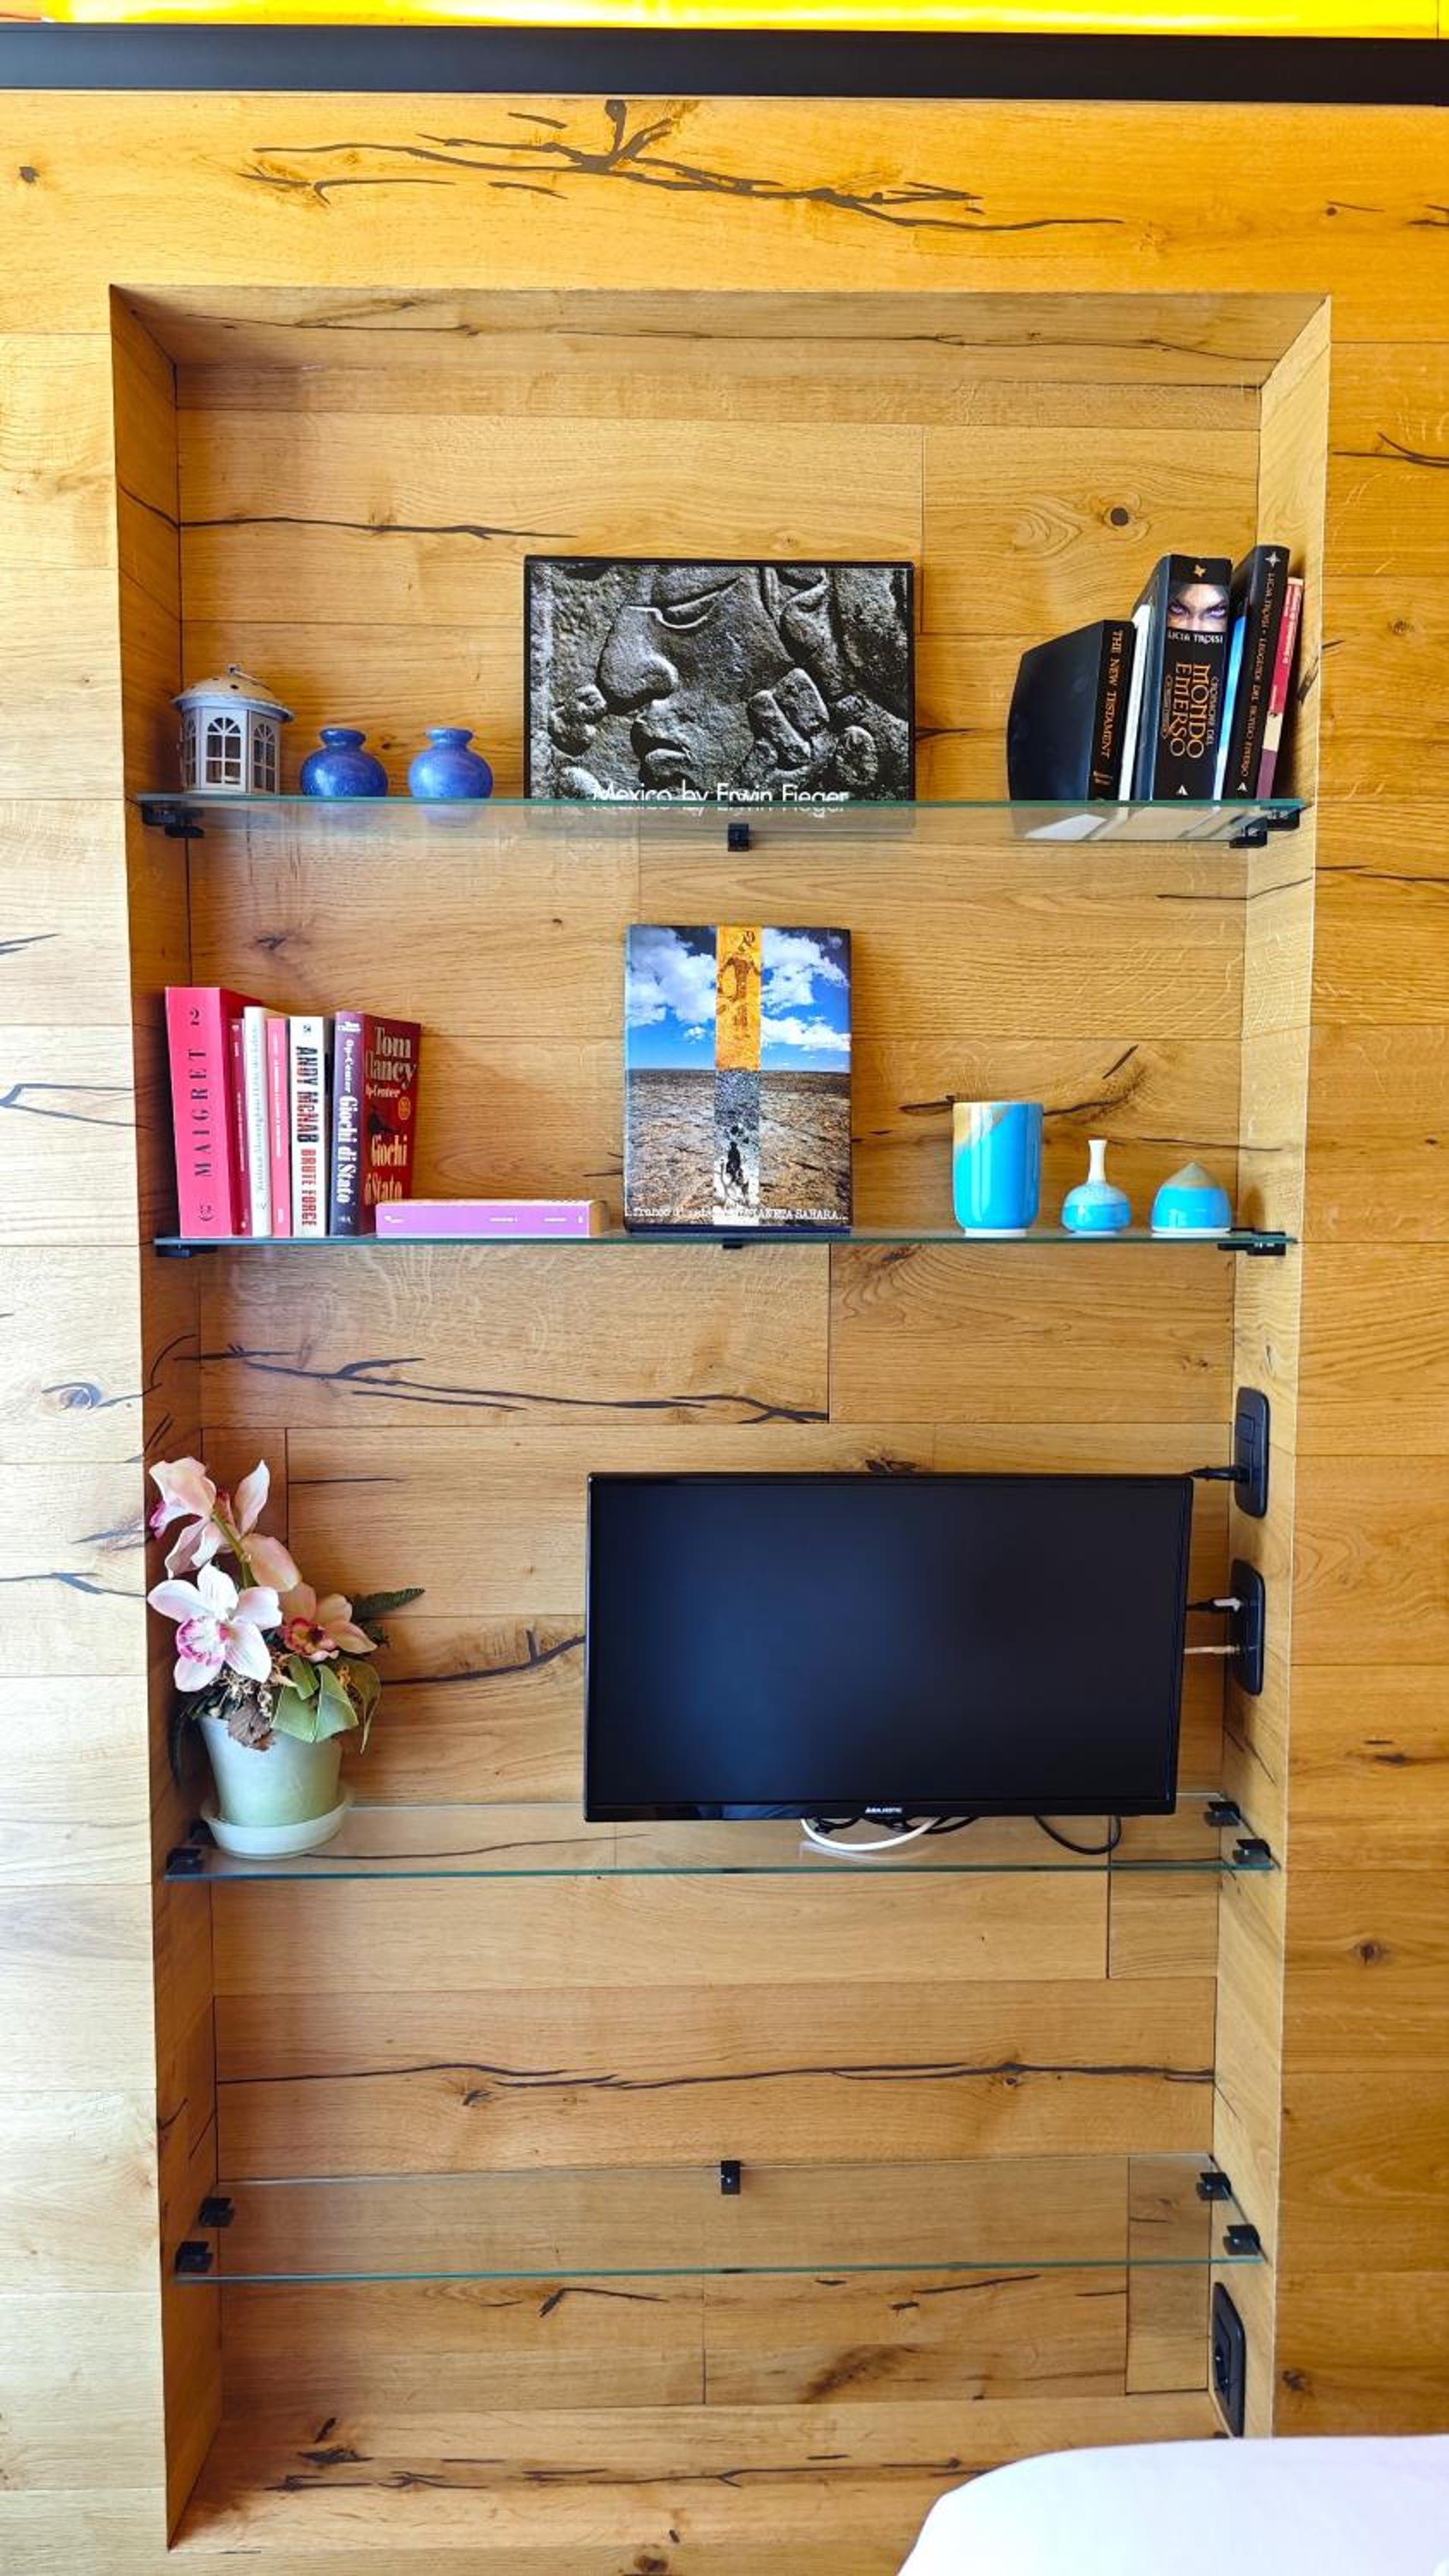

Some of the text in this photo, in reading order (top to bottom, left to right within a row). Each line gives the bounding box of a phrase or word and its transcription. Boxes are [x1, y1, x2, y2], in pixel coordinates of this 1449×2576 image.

[1101, 630, 1123, 759] THE NEW TESTAMENT
[1170, 663, 1192, 756] EMERSO
[1185, 664, 1211, 759] MONDO
[593, 781, 673, 810] Mexico
[375, 1027, 412, 1058] Tom
[296, 1046, 318, 1085] ANDY
[188, 1006, 213, 1177] MAIGRET 2
[337, 1096, 359, 1143] Giochi
[300, 1149, 317, 1186] BRUTE
[337, 1146, 357, 1162] di
[371, 1134, 408, 1167] Giochi
[336, 1163, 356, 1203] Stato
[300, 1189, 317, 1225] FORCE
